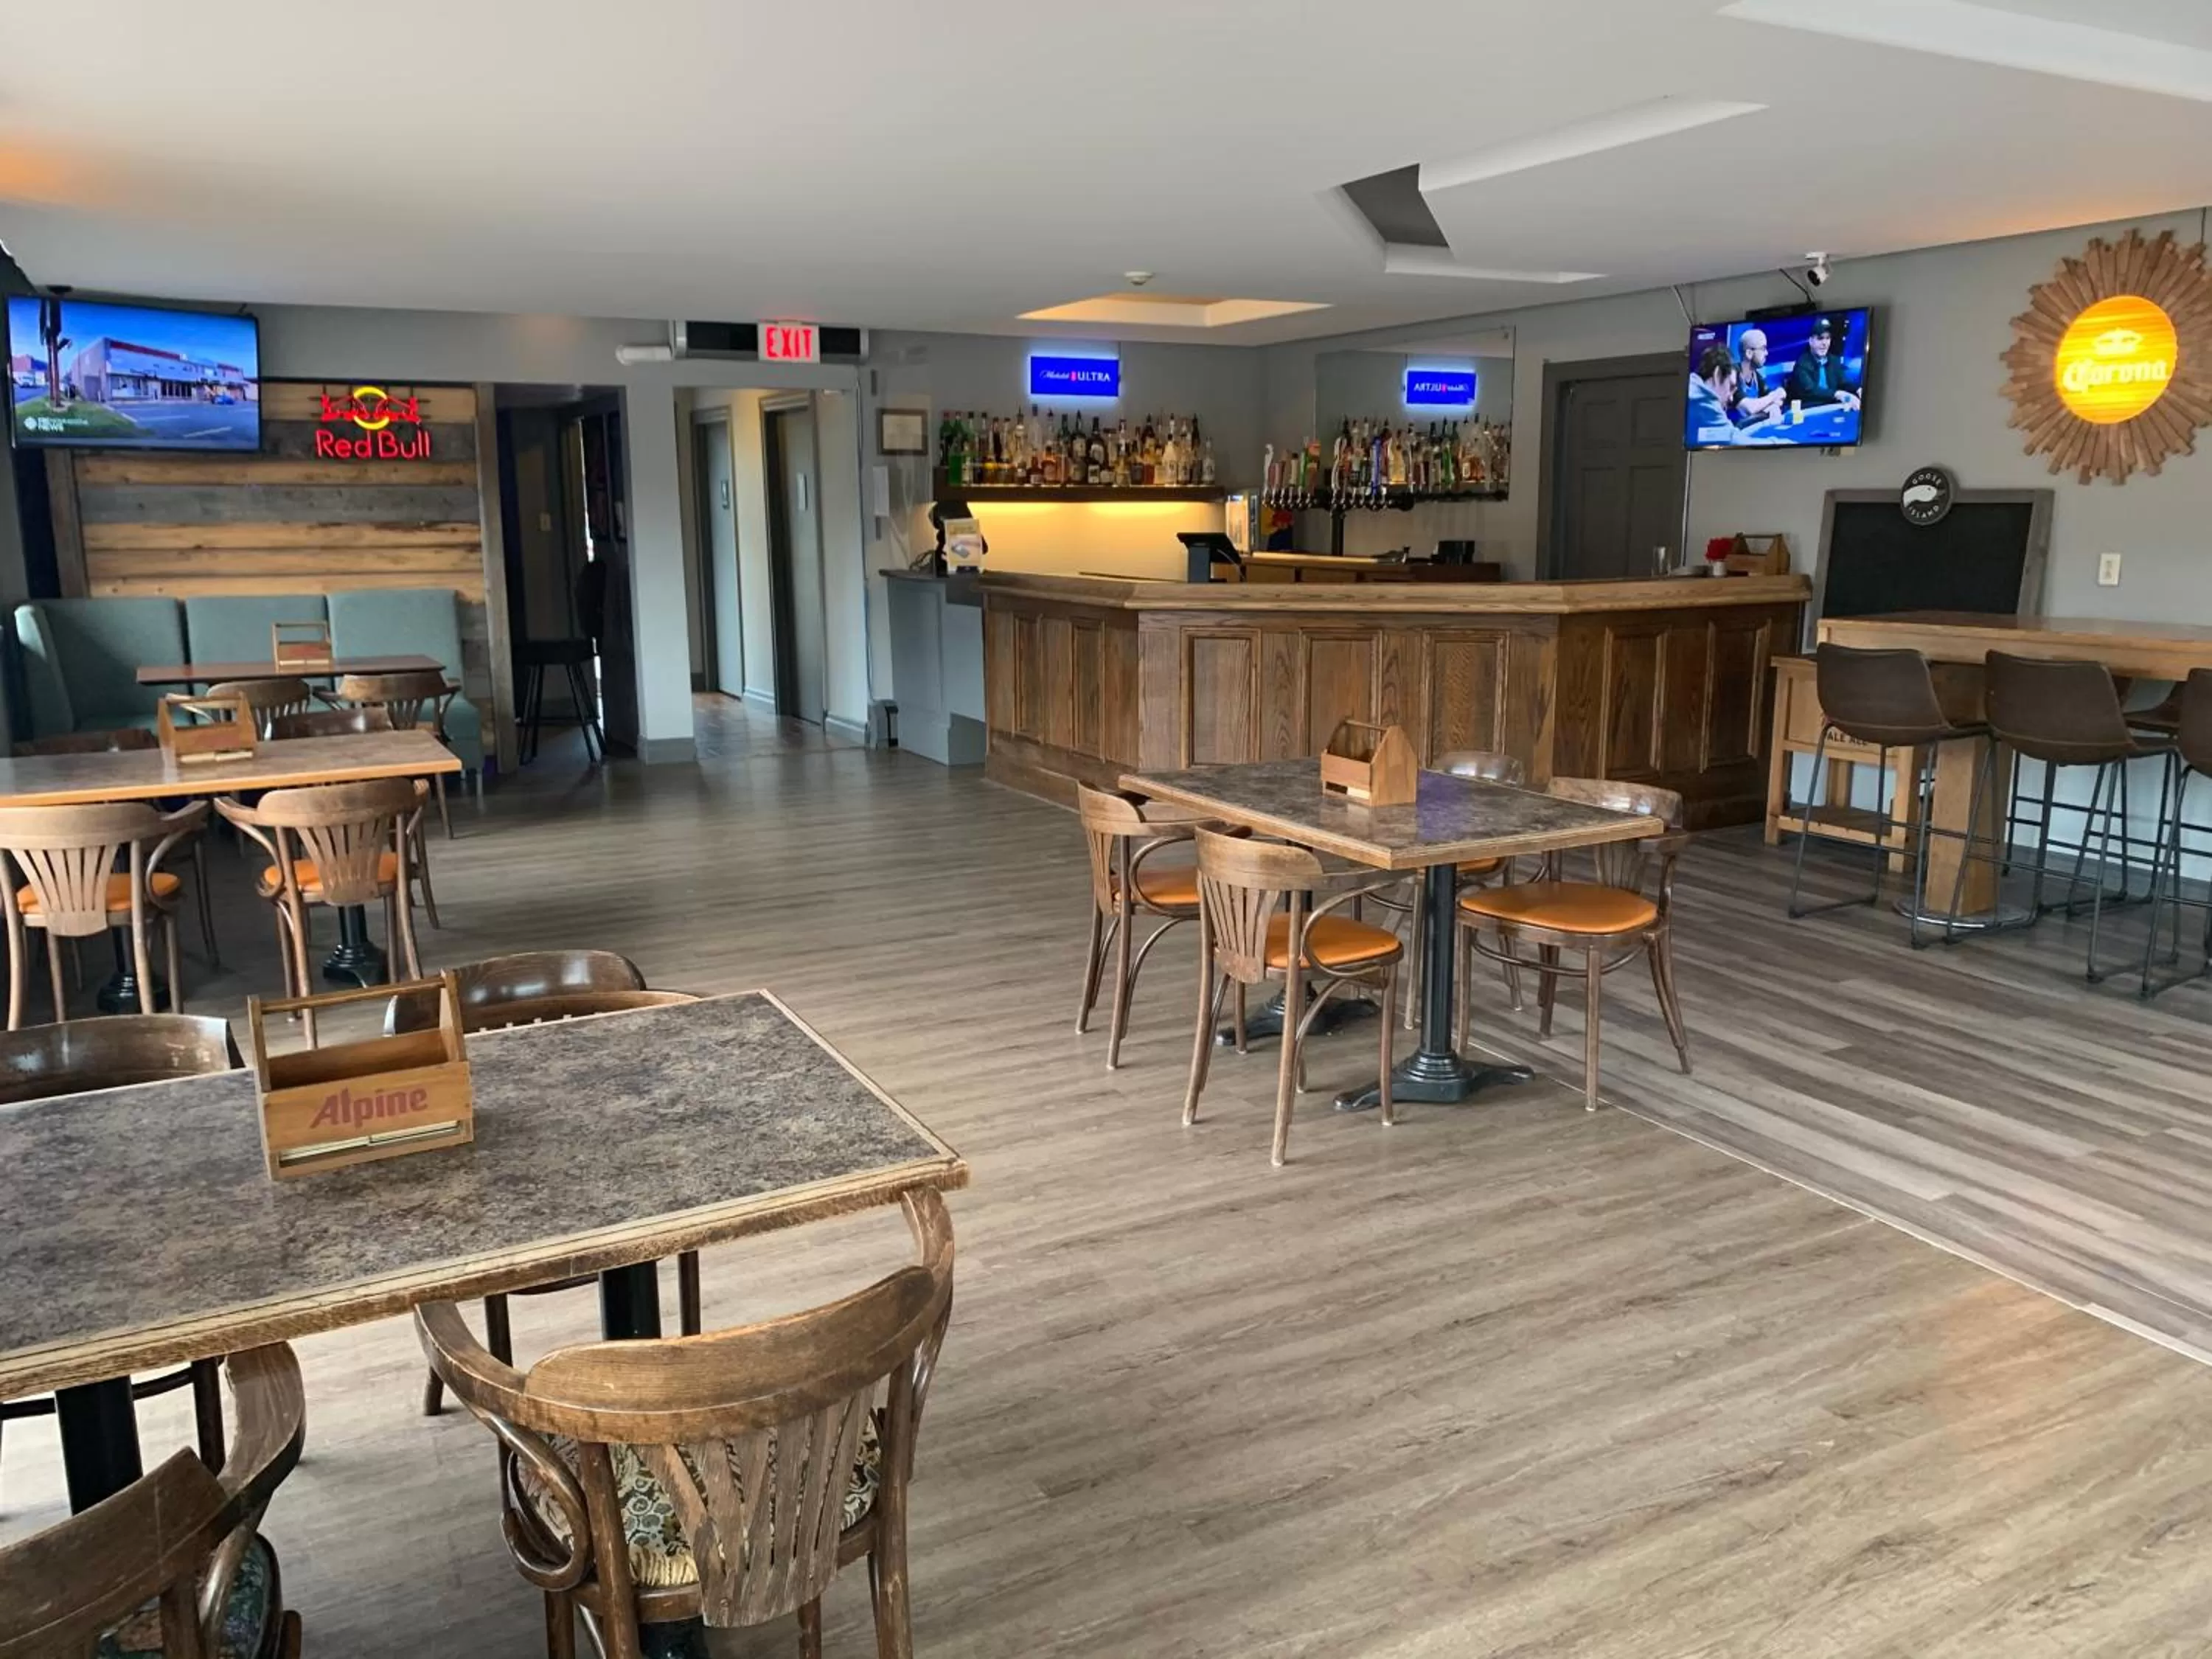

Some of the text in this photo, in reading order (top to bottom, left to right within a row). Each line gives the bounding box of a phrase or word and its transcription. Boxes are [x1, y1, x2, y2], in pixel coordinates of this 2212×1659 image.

[766, 326, 813, 359] EXIT
[1077, 371, 1111, 382] ULTRA
[2062, 359, 2167, 393] Corona
[316, 429, 431, 459] Red Bull
[310, 1086, 428, 1129] Alpine
